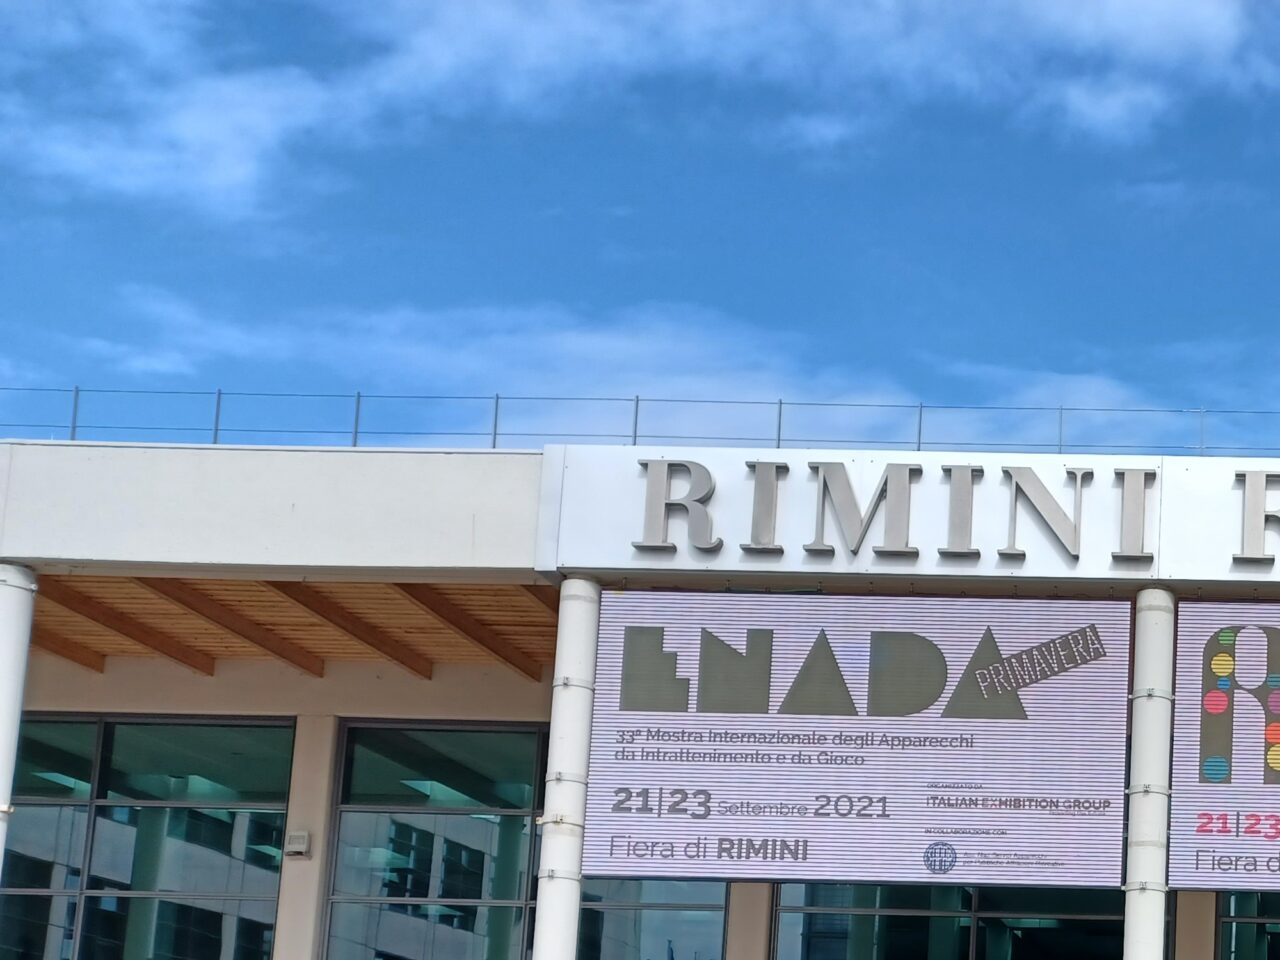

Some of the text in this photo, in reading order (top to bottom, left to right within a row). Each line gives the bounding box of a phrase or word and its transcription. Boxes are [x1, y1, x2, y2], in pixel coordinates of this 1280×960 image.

[631, 459, 1156, 560] RIMINI
[619, 625, 1029, 720] ENADA
[974, 627, 1106, 699] PRIMAVERA
[646, 728, 704, 743] Mostra
[708, 729, 828, 745] Internazionale
[832, 730, 874, 749] degli
[877, 733, 974, 750] Apparecchi
[615, 747, 865, 766] da Intrattenimento e da Gioco
[716, 800, 808, 816] Settembre
[813, 794, 890, 818] 2021
[926, 796, 1112, 811] ITALIAN EXHIBITION GROUP
[609, 836, 809, 861] Fiera di RIMINI
[1194, 850, 1259, 872] Fiera
